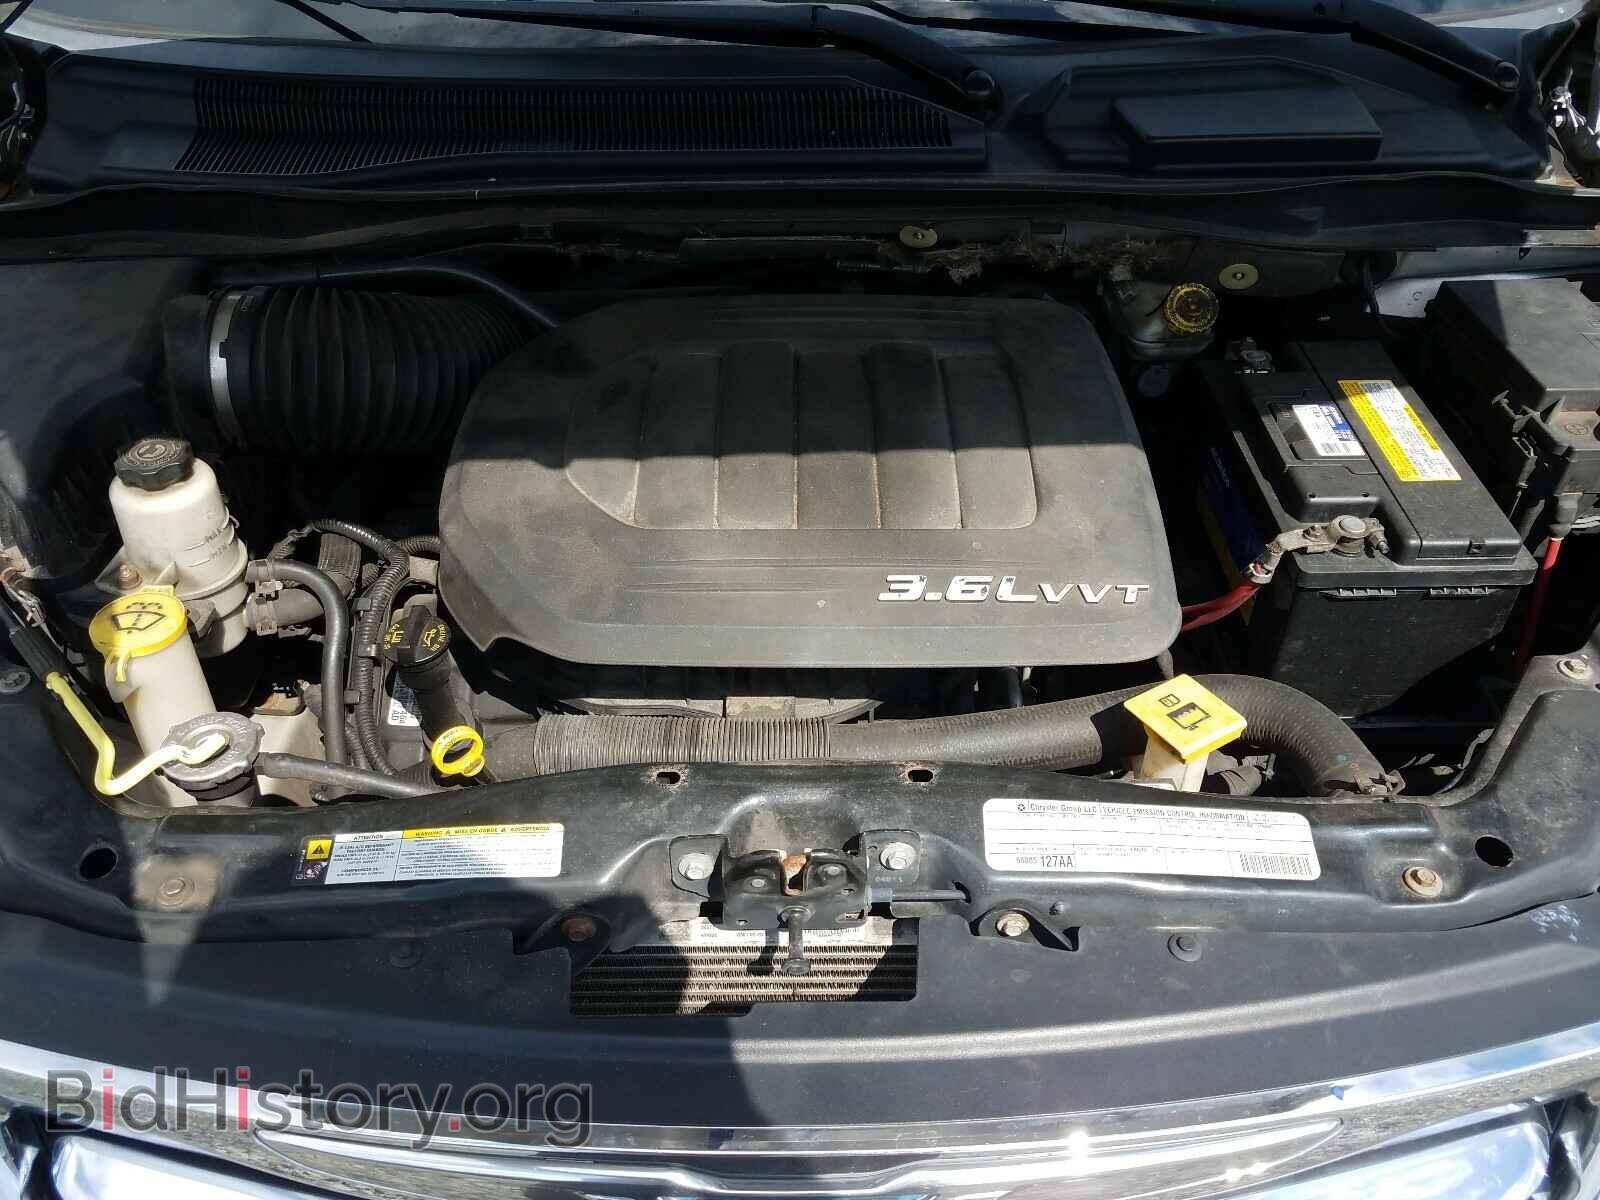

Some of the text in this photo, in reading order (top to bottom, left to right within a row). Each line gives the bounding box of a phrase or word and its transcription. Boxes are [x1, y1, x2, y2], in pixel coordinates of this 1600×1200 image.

[1030, 802, 1058, 811] Chrysler
[1060, 804, 1081, 813] Group
[1102, 806, 1131, 815] VEHICLE
[1131, 807, 1165, 816] EMISSION
[1166, 809, 1196, 817] CONTROL
[1199, 811, 1245, 821] INFORMATION
[1040, 855, 1074, 869] 127AA
